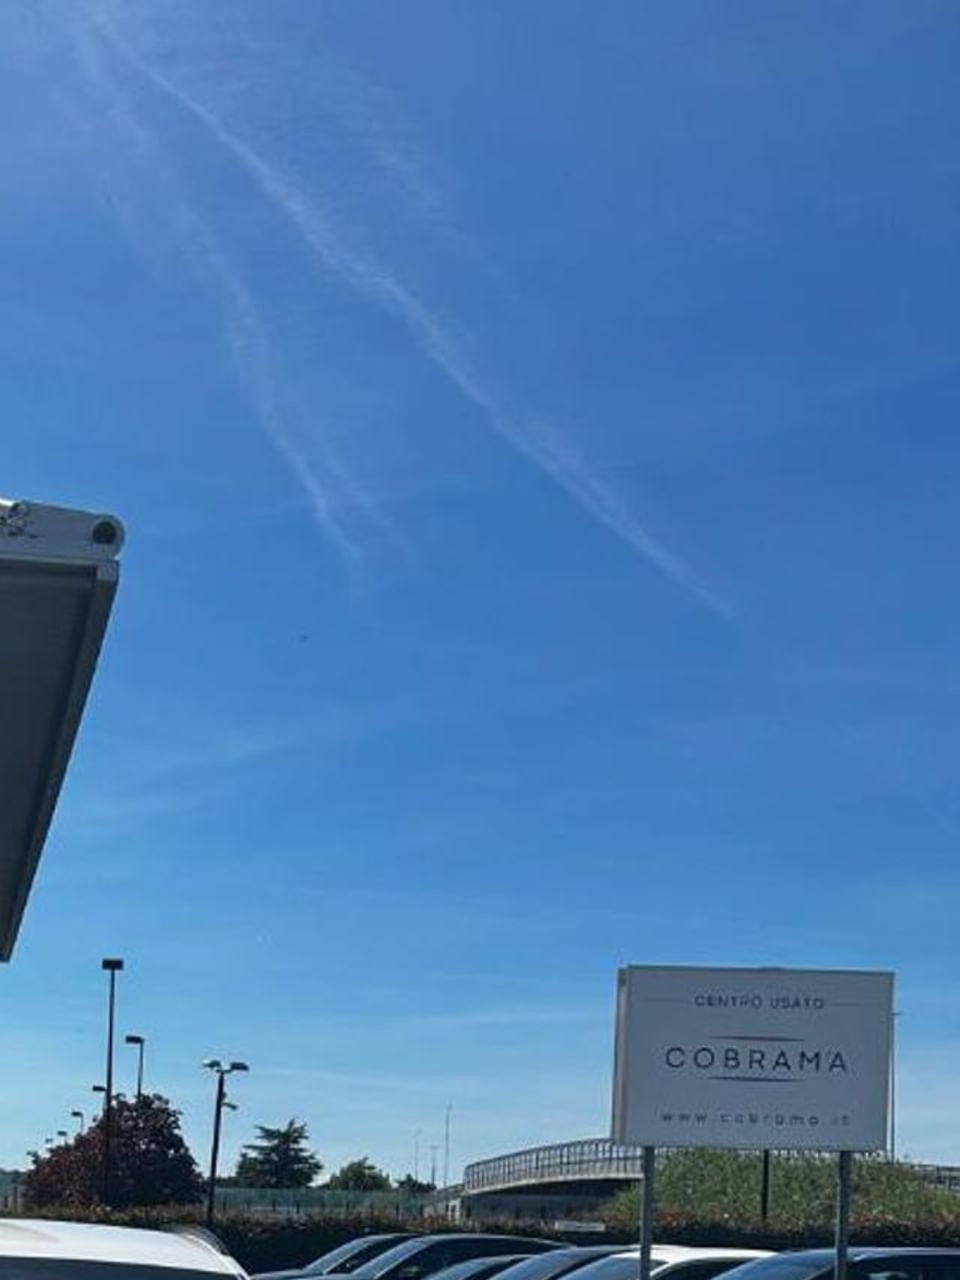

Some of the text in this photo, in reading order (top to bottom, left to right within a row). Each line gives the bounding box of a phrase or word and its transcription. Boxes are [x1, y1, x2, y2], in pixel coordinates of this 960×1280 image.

[694, 995, 825, 1010] CENTRO USATO
[665, 1047, 848, 1073] COBRAMA
